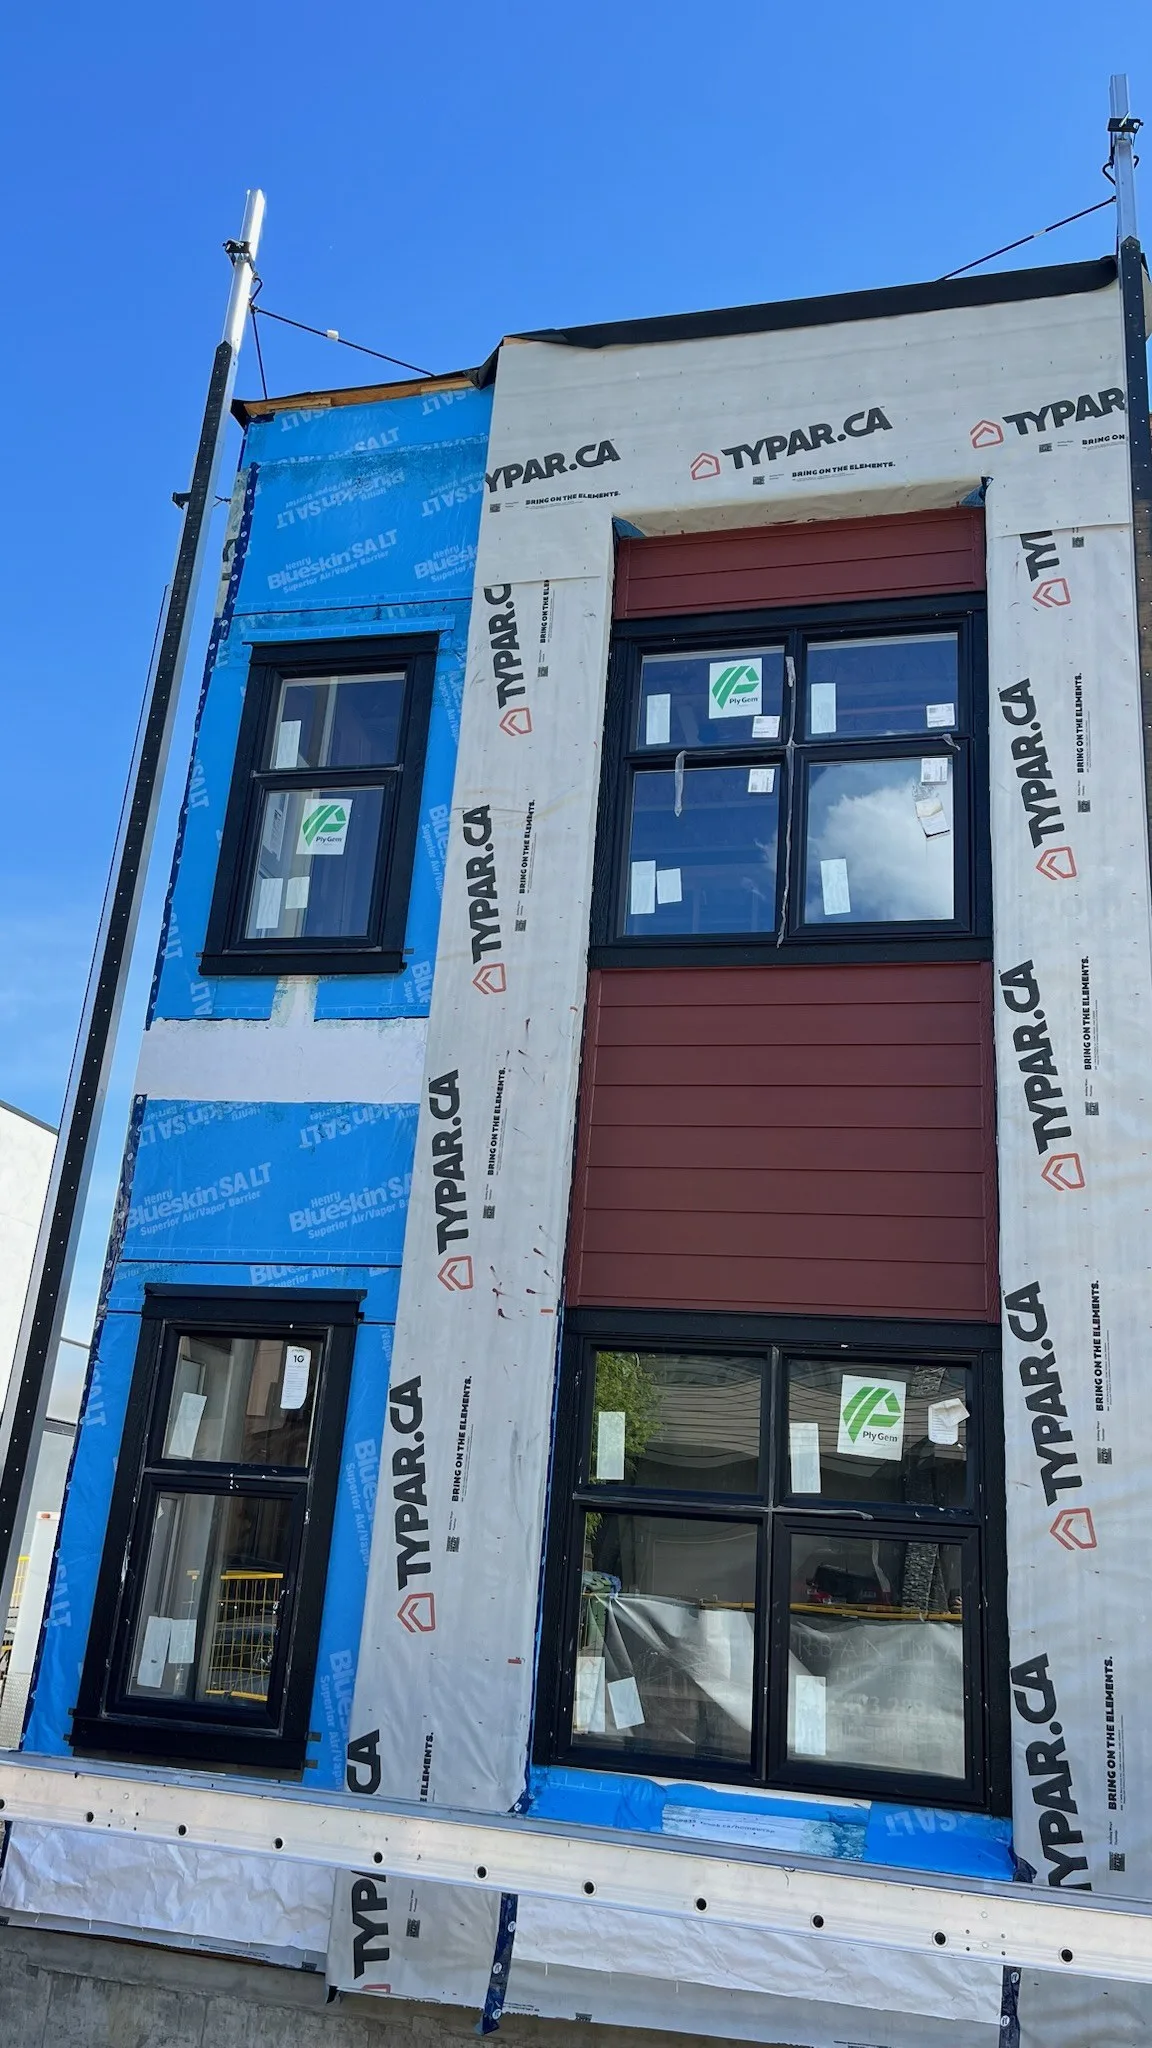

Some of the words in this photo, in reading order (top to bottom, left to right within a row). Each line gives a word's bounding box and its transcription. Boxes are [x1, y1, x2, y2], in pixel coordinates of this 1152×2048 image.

[1002, 387, 1125, 436] TYPAR
[721, 407, 893, 470] TYPAR.CA
[1082, 436, 1110, 445] BRING
[791, 470, 818, 478] BRING
[832, 466, 847, 474] THE
[849, 461, 896, 470] ELEMENTS.
[422, 486, 467, 517] SALT
[525, 497, 549, 506] BRING
[578, 491, 621, 500] ELEMENTS.
[276, 499, 322, 529] SALT
[267, 551, 350, 590] Blueskin
[352, 529, 398, 560] SALT
[286, 556, 312, 571] Henry
[433, 544, 459, 560] Henry
[283, 575, 318, 594] Superior
[542, 611, 548, 622] ON
[729, 697, 741, 705] Ply
[1074, 672, 1083, 717] ELEMENTS.
[1075, 718, 1083, 734] THE
[1076, 735, 1084, 747] ON
[999, 678, 1065, 849] TYPAR.CA
[1077, 748, 1085, 773] BRING
[524, 799, 535, 839] ELEMENTS.
[522, 839, 530, 856] THE
[521, 857, 528, 868] ON
[462, 804, 502, 965] TYPAR.CA
[519, 869, 528, 894] BRING
[1081, 955, 1090, 1007] ELEMENTS.
[1082, 1007, 1090, 1026] THE
[1083, 1026, 1091, 1040] ON
[1000, 959, 1072, 1155] TYPAR.CA
[1084, 1040, 1092, 1070] BRING
[494, 1067, 506, 1115] ELEMENTS.
[492, 1115, 500, 1133] THE
[490, 1134, 498, 1147] ON
[428, 1069, 470, 1255] TYPAR.CA
[487, 1148, 497, 1176] BRING
[127, 1186, 218, 1230] Blueskin
[218, 1162, 271, 1197] SALT
[144, 1189, 172, 1206] Henry
[289, 1187, 387, 1233] Blueskin
[311, 1191, 341, 1208] Henry
[140, 1216, 180, 1236] Superior
[182, 1202, 226, 1223] Air/Vapor
[229, 1190, 261, 1208] Barrier
[308, 1219, 348, 1239] Superior
[351, 1205, 397, 1226] Air/Vapor
[1091, 1280, 1100, 1338] ELEMENTS.
[293, 1355, 304, 1363] 10
[1093, 1338, 1101, 1360] THE
[1094, 1360, 1103, 1378] ON
[459, 1375, 472, 1431] ELEMENTS.
[1004, 1280, 1083, 1507] TYPAR.CA
[1095, 1378, 1104, 1412] BRING
[457, 1431, 466, 1451] THE
[862, 1430, 877, 1442] Ply
[878, 1433, 898, 1442] Gem
[455, 1452, 463, 1468] ON
[346, 1462, 361, 1510] Superior
[389, 1374, 431, 1591] TYPAR.CA
[452, 1469, 462, 1502] BRING
[320, 1674, 335, 1728] Superior
[1104, 1656, 1115, 1723] ELEMENTS.
[1105, 1725, 1115, 1749] THE
[420, 1732, 434, 1796] ELEMENTS.
[1106, 1750, 1116, 1770] ON
[1107, 1771, 1117, 1811] BRING
